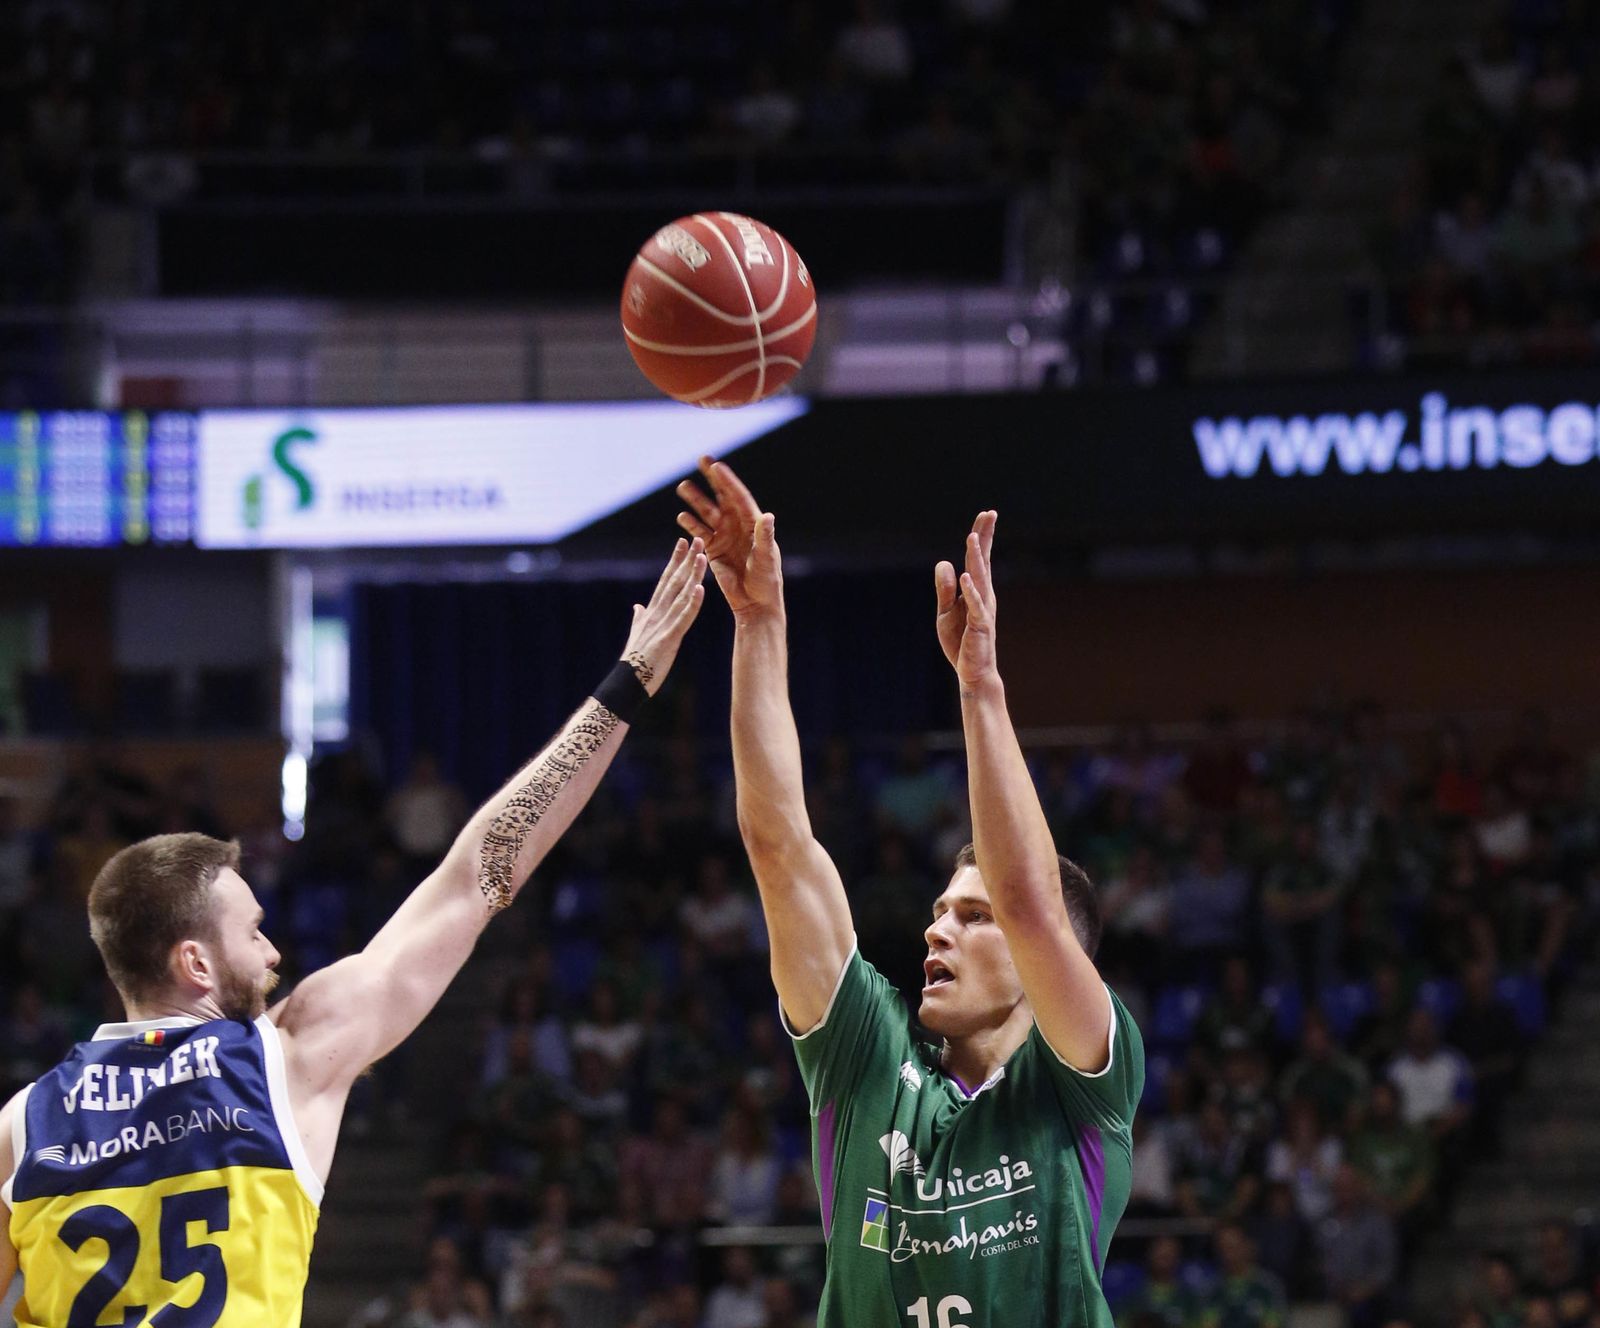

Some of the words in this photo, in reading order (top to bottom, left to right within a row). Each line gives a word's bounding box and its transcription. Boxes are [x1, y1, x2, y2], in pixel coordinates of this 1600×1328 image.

[1194, 392, 1600, 478] www.inse
[916, 1154, 1033, 1201] Unicaja
[981, 1243, 1007, 1257] COSTA
[1007, 1240, 1022, 1251] DEL
[1023, 1235, 1040, 1246] SOL
